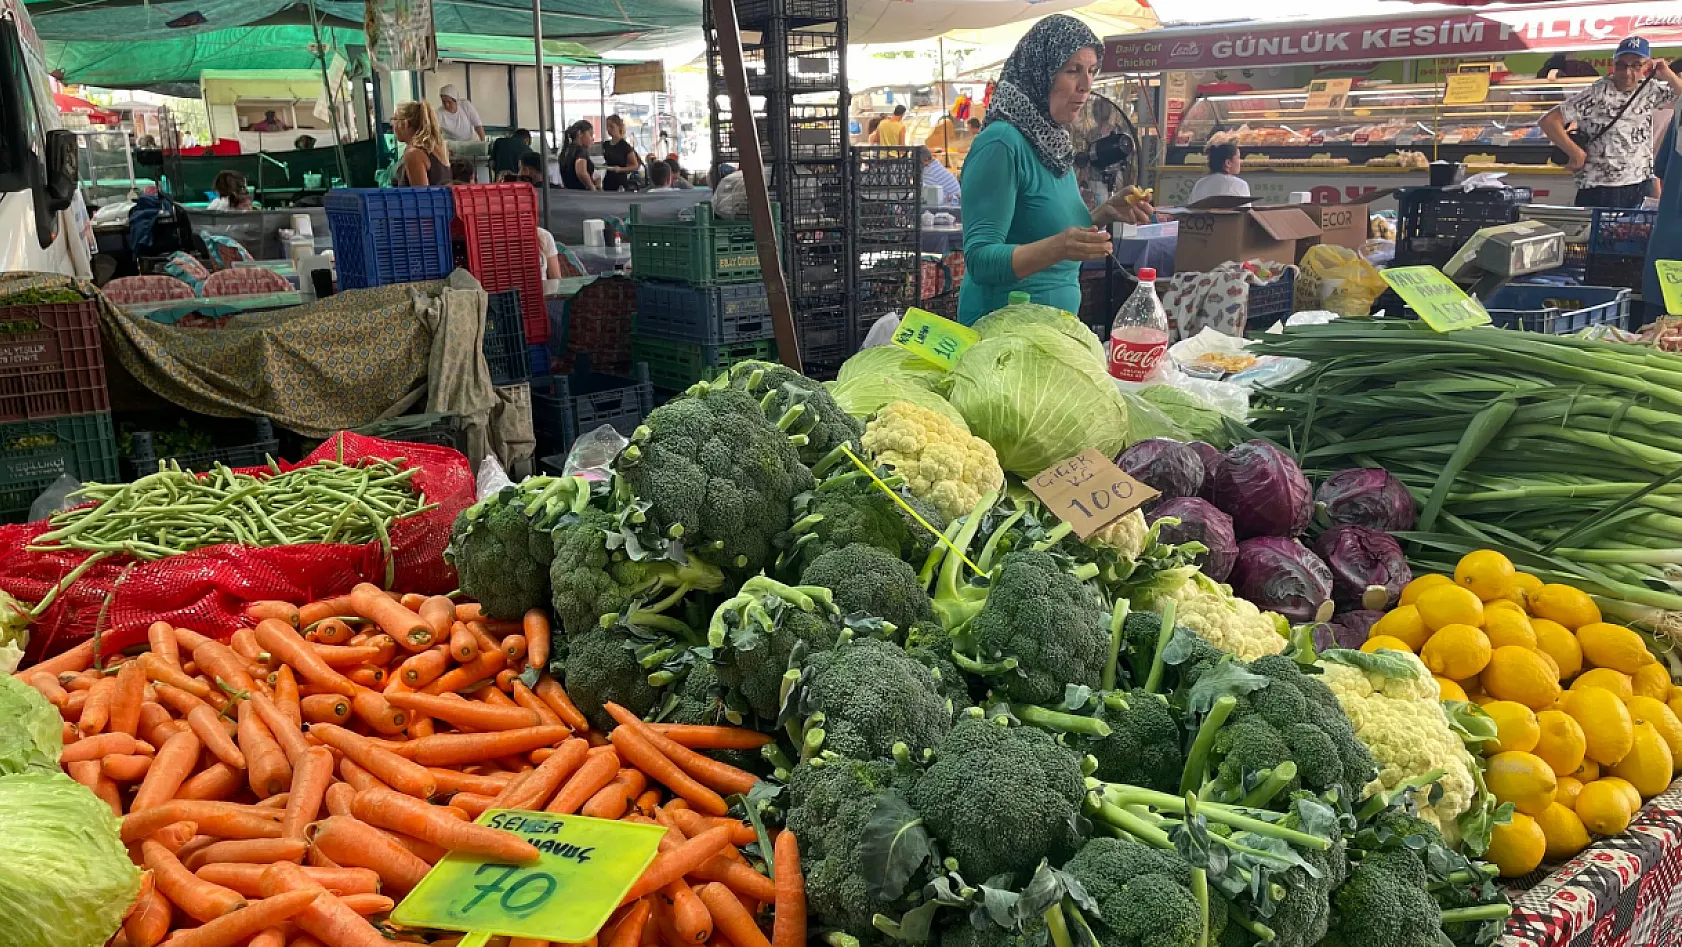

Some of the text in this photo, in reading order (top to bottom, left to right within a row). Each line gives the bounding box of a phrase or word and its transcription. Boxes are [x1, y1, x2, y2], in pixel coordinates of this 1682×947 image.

[1115, 43, 1140, 55] Daily
[1212, 30, 1351, 59] GÜNLÜK
[1362, 20, 1485, 49] KESİM
[1116, 57, 1158, 67] Chicken
[933, 335, 957, 359] 100
[1112, 343, 1166, 368] Coca-Co
[1067, 481, 1134, 519] 100
[461, 863, 558, 914] 70
